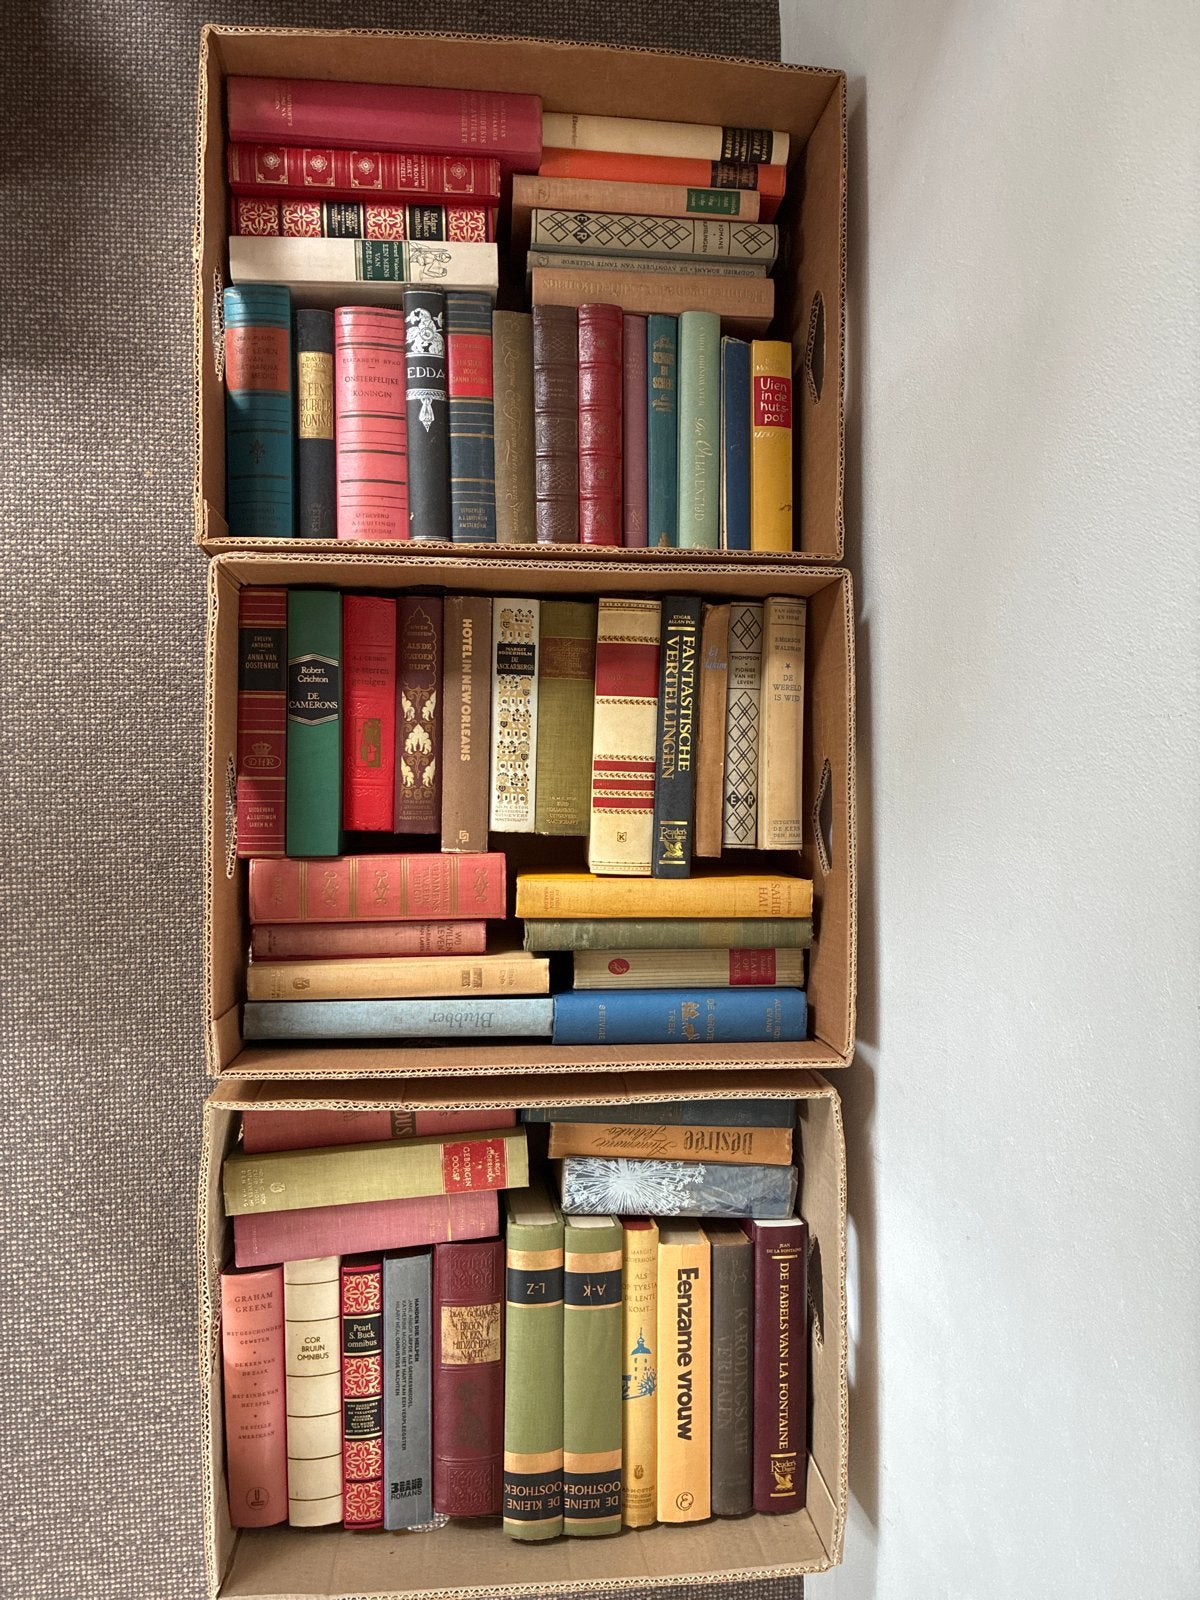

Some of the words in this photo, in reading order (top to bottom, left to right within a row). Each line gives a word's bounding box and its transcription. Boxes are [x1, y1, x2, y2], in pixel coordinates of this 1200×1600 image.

[414, 208, 422, 239] omnibus
[422, 210, 431, 238] Wallace
[430, 212, 438, 234] Edgar
[621, 262, 635, 270] VAN
[694, 267, 720, 275] BOMANS
[724, 268, 755, 277] GODFRIED
[407, 366, 446, 379] EDDA
[344, 375, 400, 385] ONSTERFELIJKE
[760, 377, 787, 392] Uien
[307, 383, 327, 396] EEN
[353, 390, 392, 399] KONINGIN
[761, 390, 772, 401] in
[774, 392, 787, 403] de
[300, 399, 332, 413] BURGER
[760, 401, 789, 413] huts-
[301, 414, 332, 429] KONING
[764, 413, 785, 424] pot
[462, 618, 473, 658] HOTEL
[421, 642, 432, 650] DE
[245, 662, 279, 670] OOSTENRIJK
[301, 666, 325, 674] Robert
[462, 660, 472, 673] IN
[297, 675, 329, 684] Crichton
[783, 674, 794, 682] DE
[461, 675, 472, 704] NEW
[773, 683, 802, 692] WERELD
[307, 692, 320, 700] DE
[774, 694, 782, 702] IS
[289, 701, 338, 709] CAMERONS
[662, 635, 680, 780] VERTELLINGEN
[678, 635, 696, 772] FANTASTISCHE
[460, 704, 471, 762] ORLEANS
[730, 794, 737, 805] E
[747, 794, 753, 805] R
[771, 883, 781, 915] SAHIB
[436, 925, 445, 951] LEVEN
[445, 923, 454, 952] WILLEN
[706, 998, 715, 1010] DE
[432, 1012, 495, 1029] Blubber
[667, 1009, 676, 1034] TREK
[706, 1013, 715, 1041] GROTE
[683, 1130, 753, 1156] Désirée
[451, 1155, 461, 1181] OOGST
[462, 1146, 472, 1187] GEBORGEN
[634, 1272, 648, 1280] ALS
[779, 1262, 790, 1281] DE
[526, 1282, 546, 1295] L-Z
[583, 1284, 607, 1297] A-K
[234, 1291, 274, 1304] GRAHAM
[635, 1293, 656, 1302] LENTE
[235, 1302, 273, 1314] GREENE
[779, 1284, 790, 1330] FABELS
[677, 1266, 700, 1366] Eenzame
[353, 1323, 372, 1332] Pearl
[239, 1336, 270, 1346] GEWETEN
[304, 1336, 321, 1344] COR
[357, 1330, 376, 1339] Buck
[347, 1338, 378, 1348] omnibus
[779, 1331, 790, 1359] VAN
[296, 1352, 330, 1361] OMNIBUS
[251, 1368, 269, 1376] ZAAK
[779, 1362, 790, 1379] LA
[717, 1335, 733, 1429] VERHALEN
[734, 1307, 749, 1454] KAROLINGSCHE
[245, 1391, 266, 1399] EINDE
[266, 1388, 279, 1396] VAN
[677, 1368, 693, 1440] vrouw
[779, 1382, 790, 1450] FONTAINE
[249, 1422, 272, 1430] STILLE
[238, 1430, 276, 1440] AMERIKAAN
[390, 1488, 423, 1501] ROMANS
[504, 1481, 563, 1497] OOSTHOEK
[564, 1481, 622, 1496] OOSTHOEK
[506, 1498, 543, 1511] KLEINE
[546, 1495, 561, 1508] DE
[564, 1498, 601, 1510] KLEINE
[605, 1495, 619, 1508] DE
